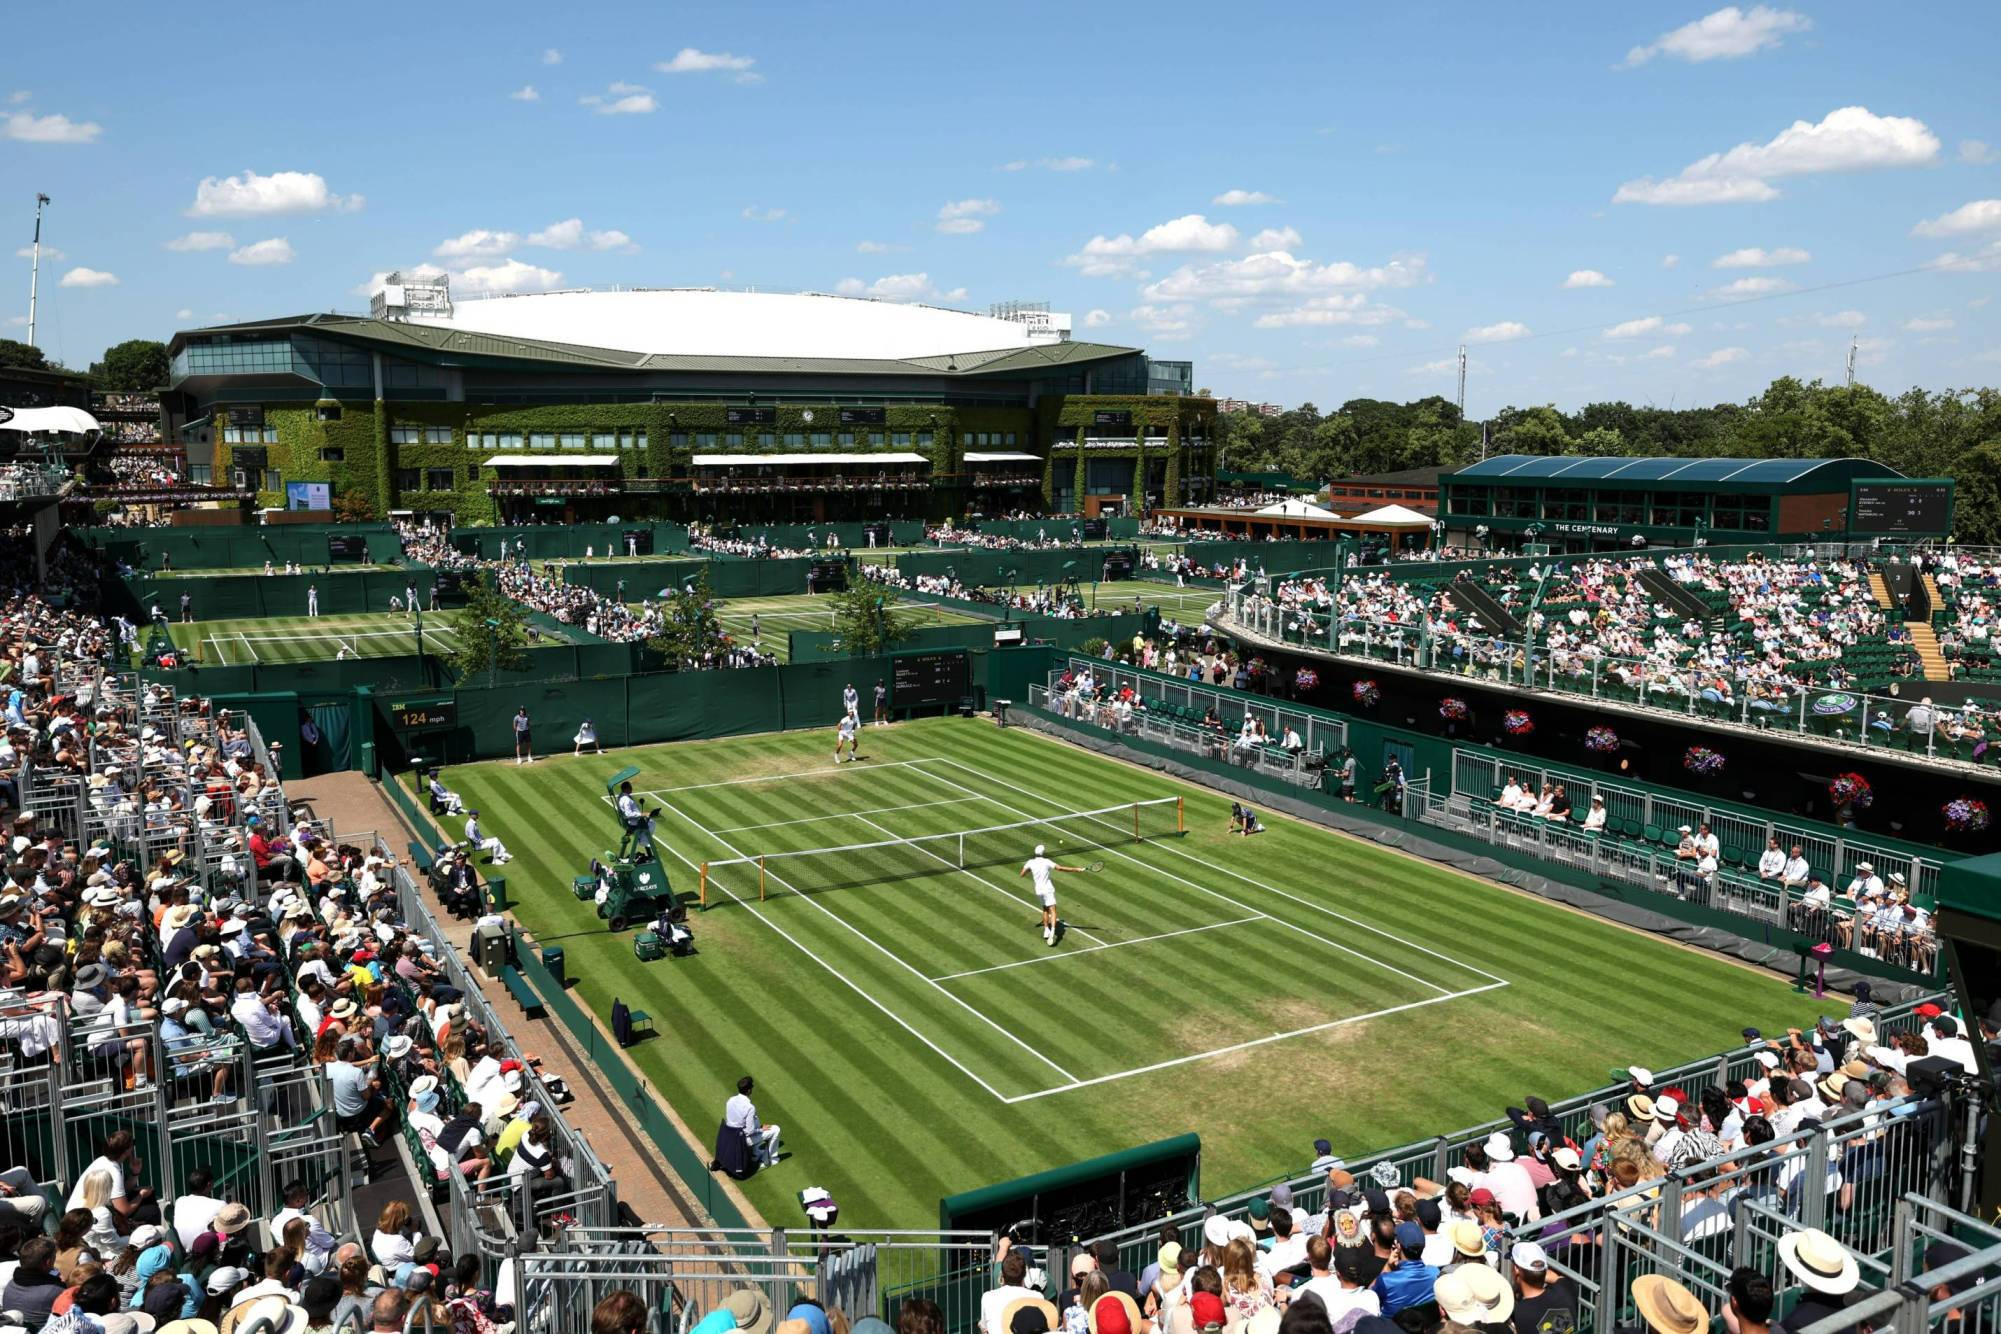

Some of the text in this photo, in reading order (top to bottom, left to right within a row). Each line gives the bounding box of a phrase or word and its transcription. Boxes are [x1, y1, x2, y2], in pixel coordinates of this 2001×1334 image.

[1555, 524, 1619, 534] THE CENTENARY
[403, 713, 426, 725] 124
[633, 884, 657, 892] ARCLAYS
